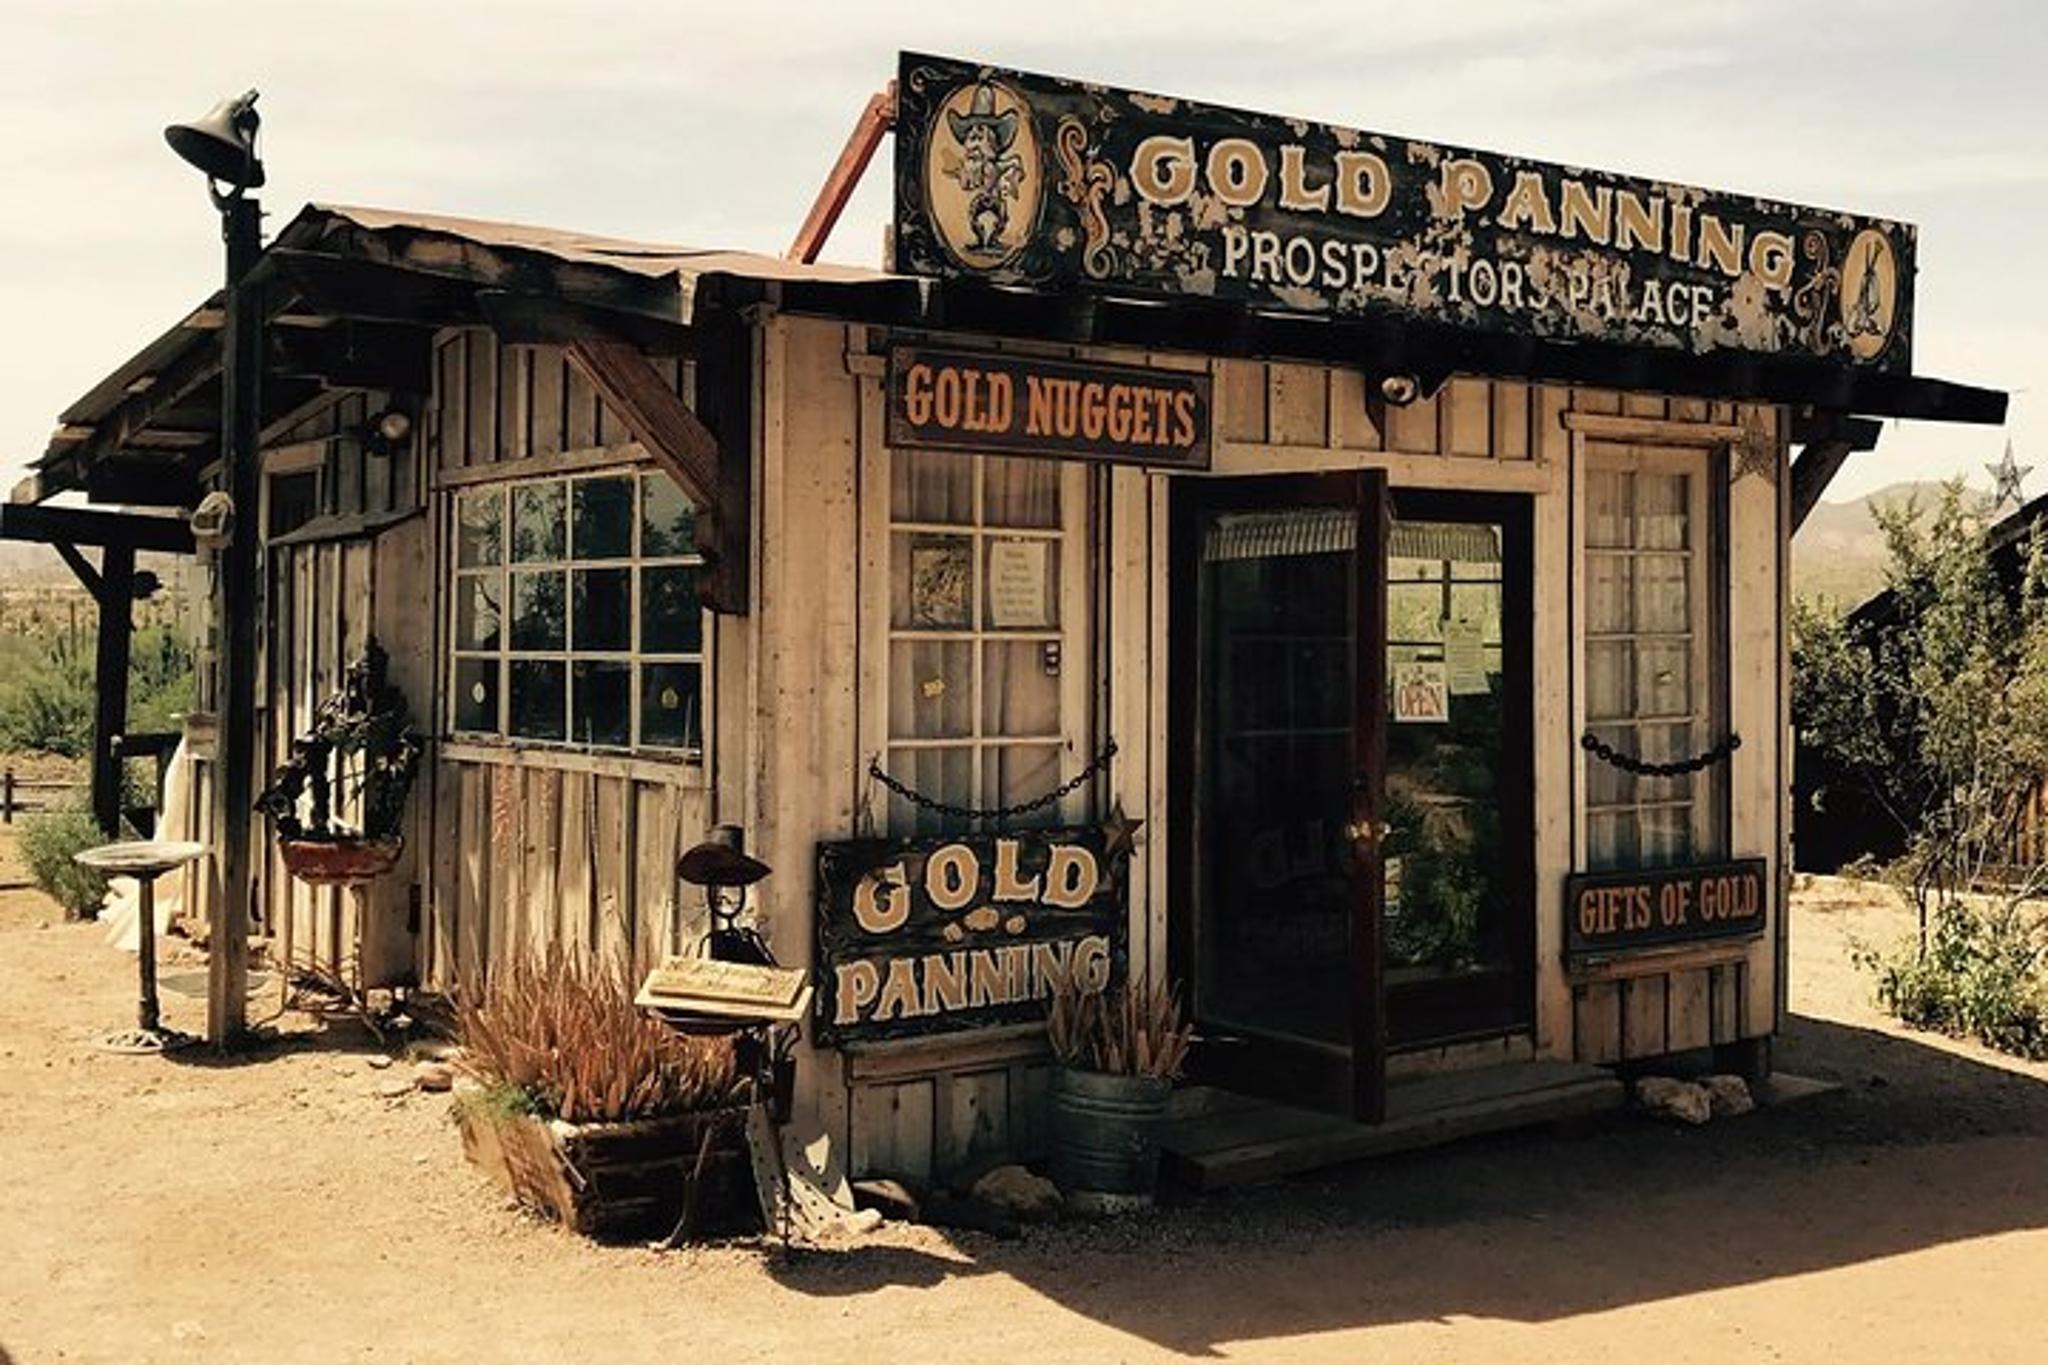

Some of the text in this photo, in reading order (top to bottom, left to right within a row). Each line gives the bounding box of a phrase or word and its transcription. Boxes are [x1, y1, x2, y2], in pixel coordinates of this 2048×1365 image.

[1130, 136, 1795, 290] GOLD PANNING
[905, 364, 1196, 448] GOLD NUGGETS
[853, 839, 1099, 934] GOLD
[1580, 874, 1759, 934] GIFTS OF GOLD
[834, 935, 1110, 1025] PANNING
